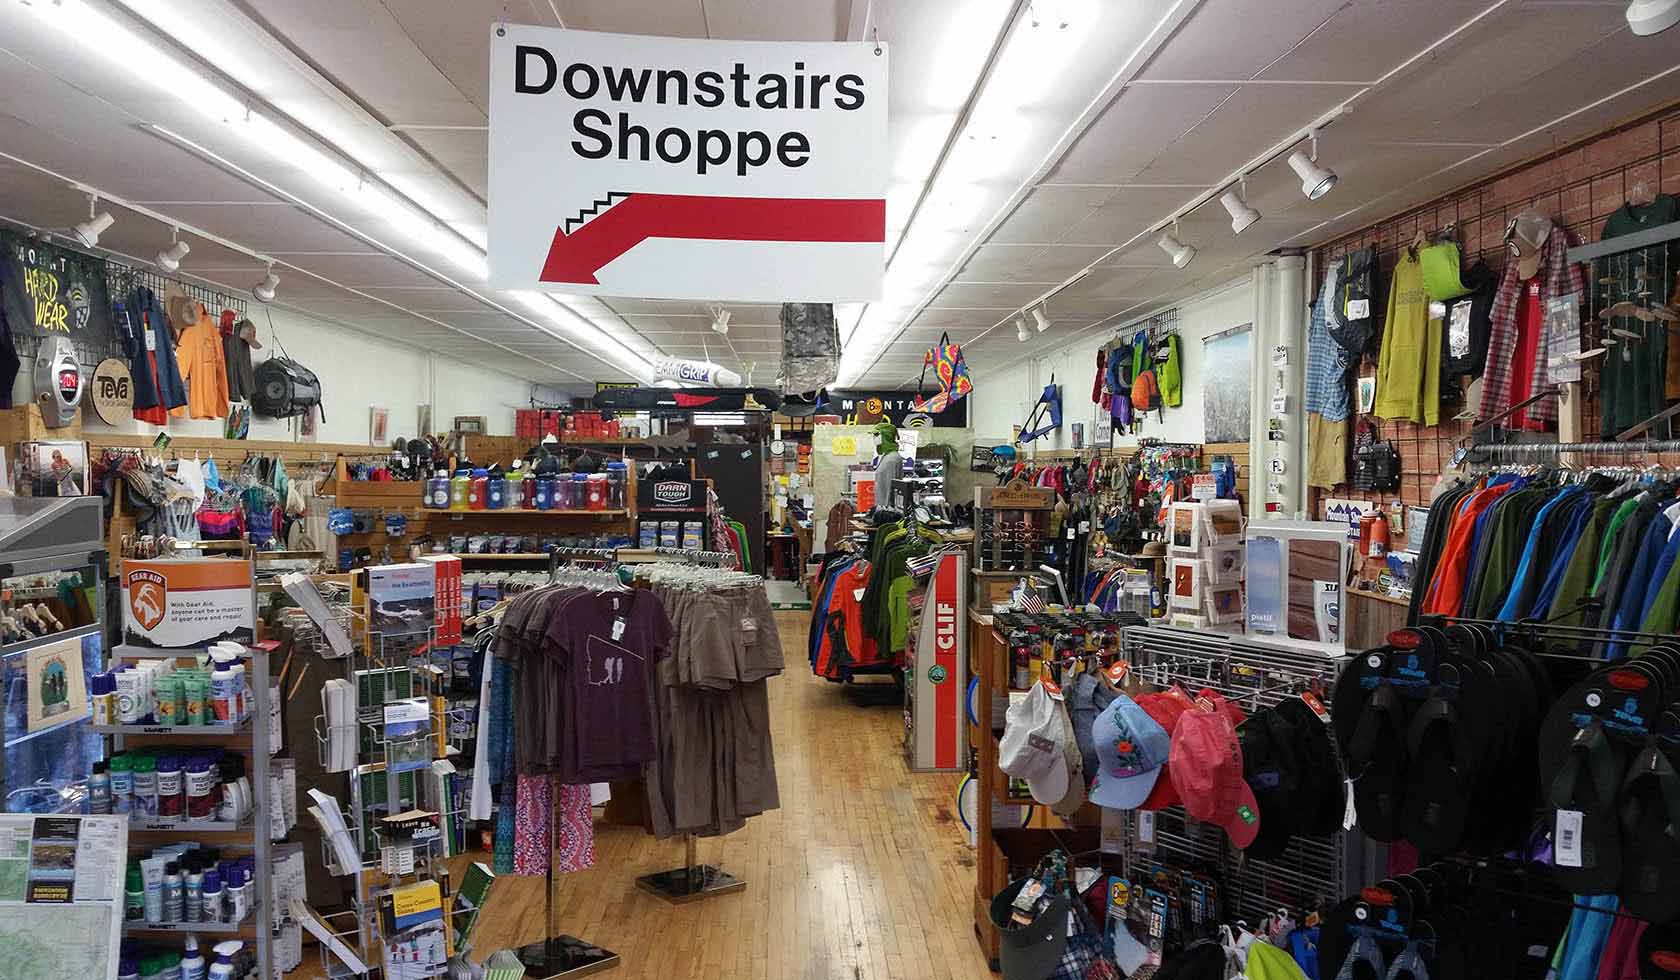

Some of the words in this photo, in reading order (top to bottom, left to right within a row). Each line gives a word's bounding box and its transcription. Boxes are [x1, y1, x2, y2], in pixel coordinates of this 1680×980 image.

[515, 45, 865, 110] Downstairs
[571, 109, 810, 176] Shoppe
[23, 267, 60, 302] HARD
[35, 300, 70, 333] WEAR
[680, 363, 708, 380] GRIP
[149, 572, 162, 583] AID
[937, 603, 954, 650] CLIF
